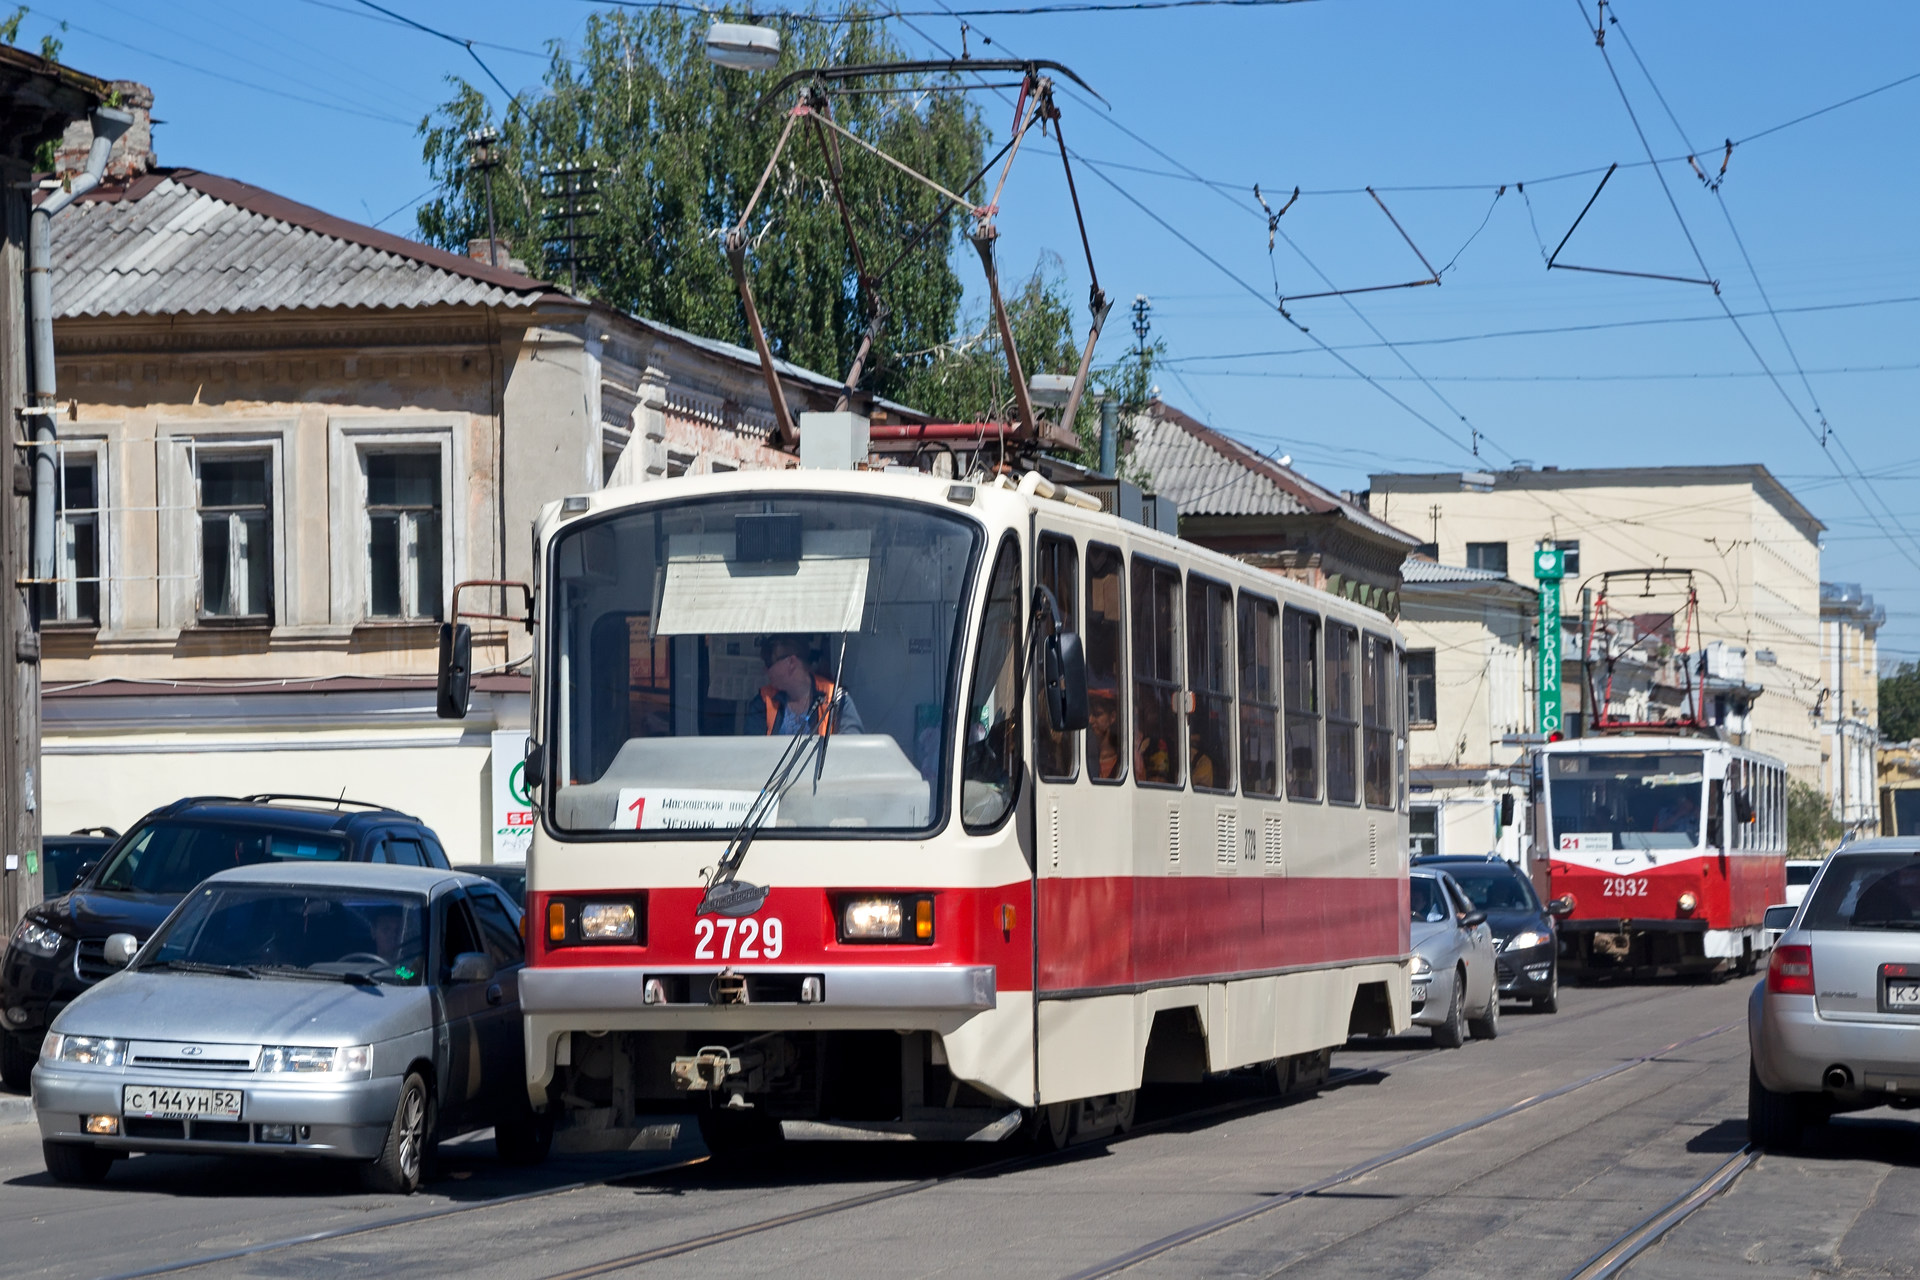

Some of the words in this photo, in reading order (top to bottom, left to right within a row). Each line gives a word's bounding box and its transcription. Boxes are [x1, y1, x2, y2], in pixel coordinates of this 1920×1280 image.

[628, 797, 646, 829] 1
[662, 798, 724, 811] Московский
[497, 827, 533, 837] exp
[1245, 828, 1256, 860] 2729
[1562, 838, 1579, 849] 21
[1603, 878, 1648, 897] 2932
[695, 917, 783, 960] 2729
[215, 1092, 234, 1107] 52
